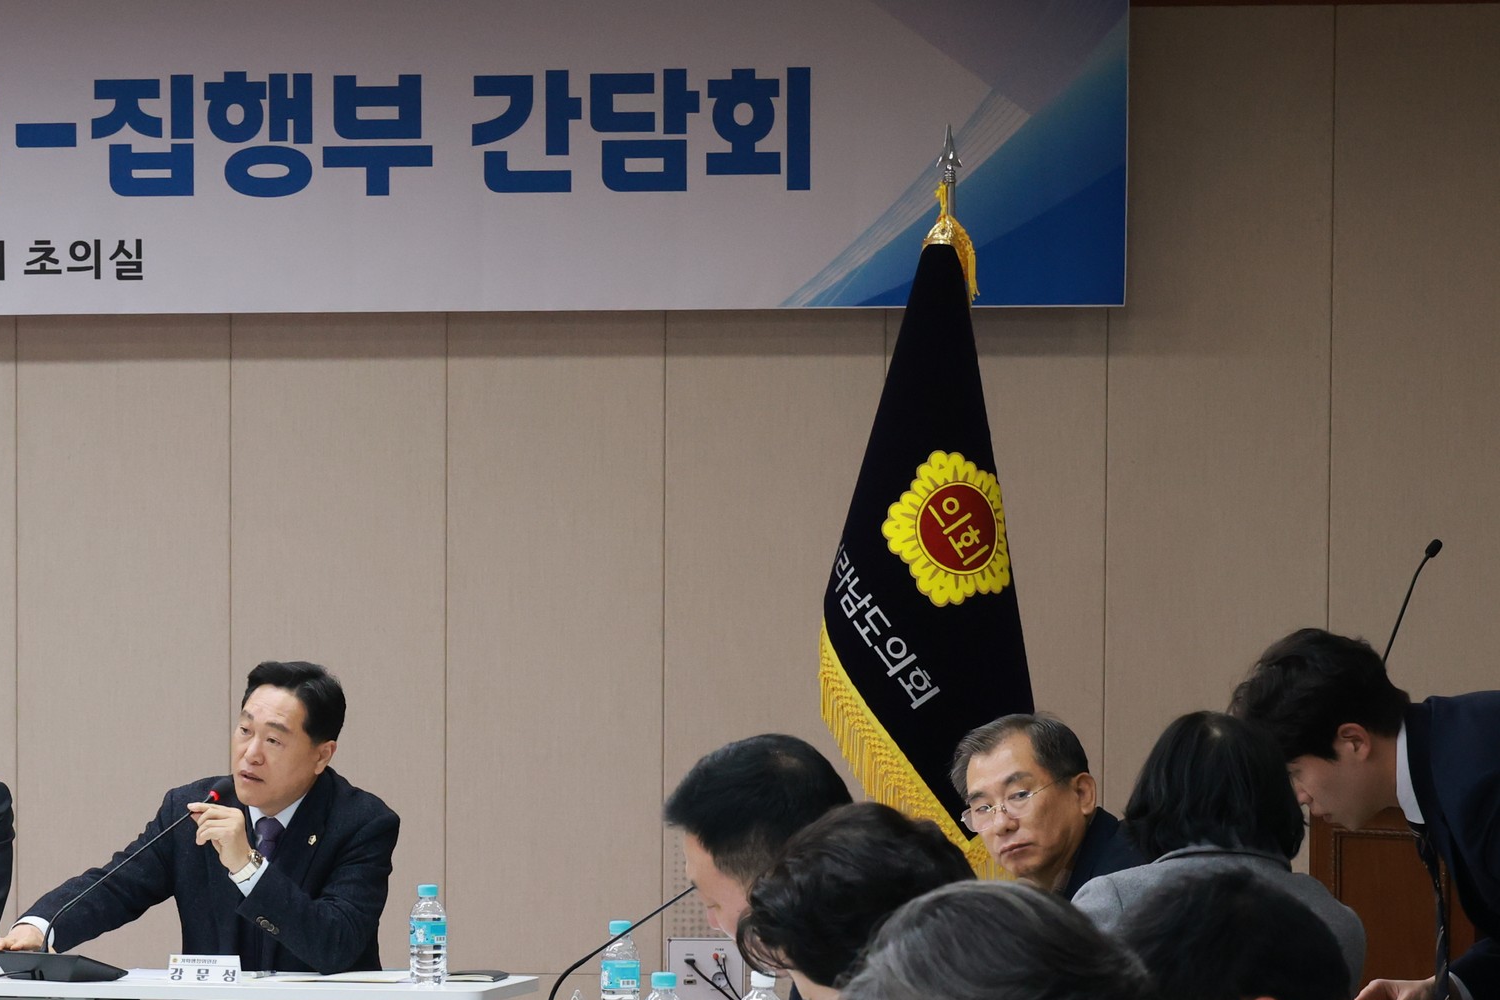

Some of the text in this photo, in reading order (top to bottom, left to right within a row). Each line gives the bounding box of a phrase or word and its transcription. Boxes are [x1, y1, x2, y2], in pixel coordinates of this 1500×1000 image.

[472, 67, 812, 194] 간담회
[23, 239, 145, 282] 초의실
[928, 496, 990, 566] 의회
